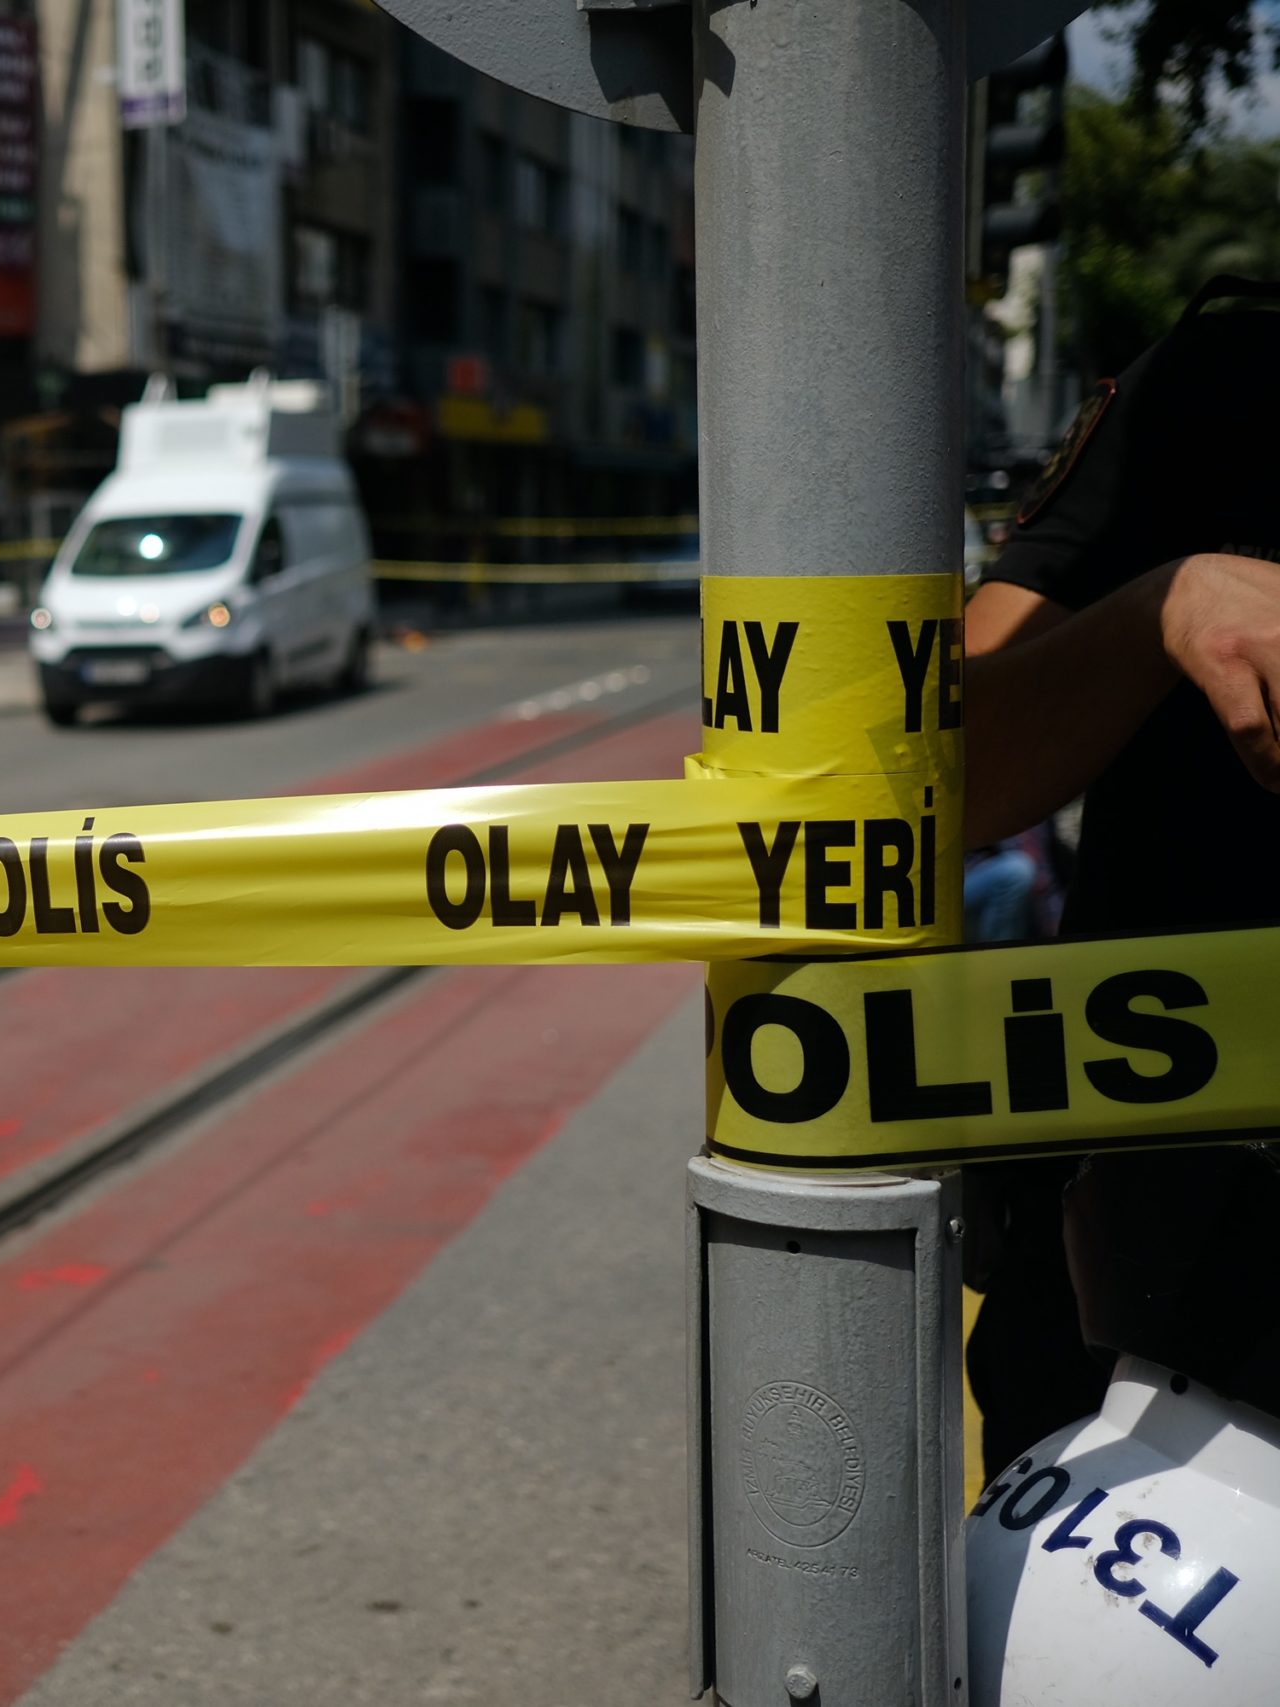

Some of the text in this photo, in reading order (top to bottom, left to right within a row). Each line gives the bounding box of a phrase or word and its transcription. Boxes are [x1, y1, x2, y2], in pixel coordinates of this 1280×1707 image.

[425, 823, 650, 930] OLAY
[736, 786, 937, 930] YERİ
[704, 968, 1218, 1124] OLİS
